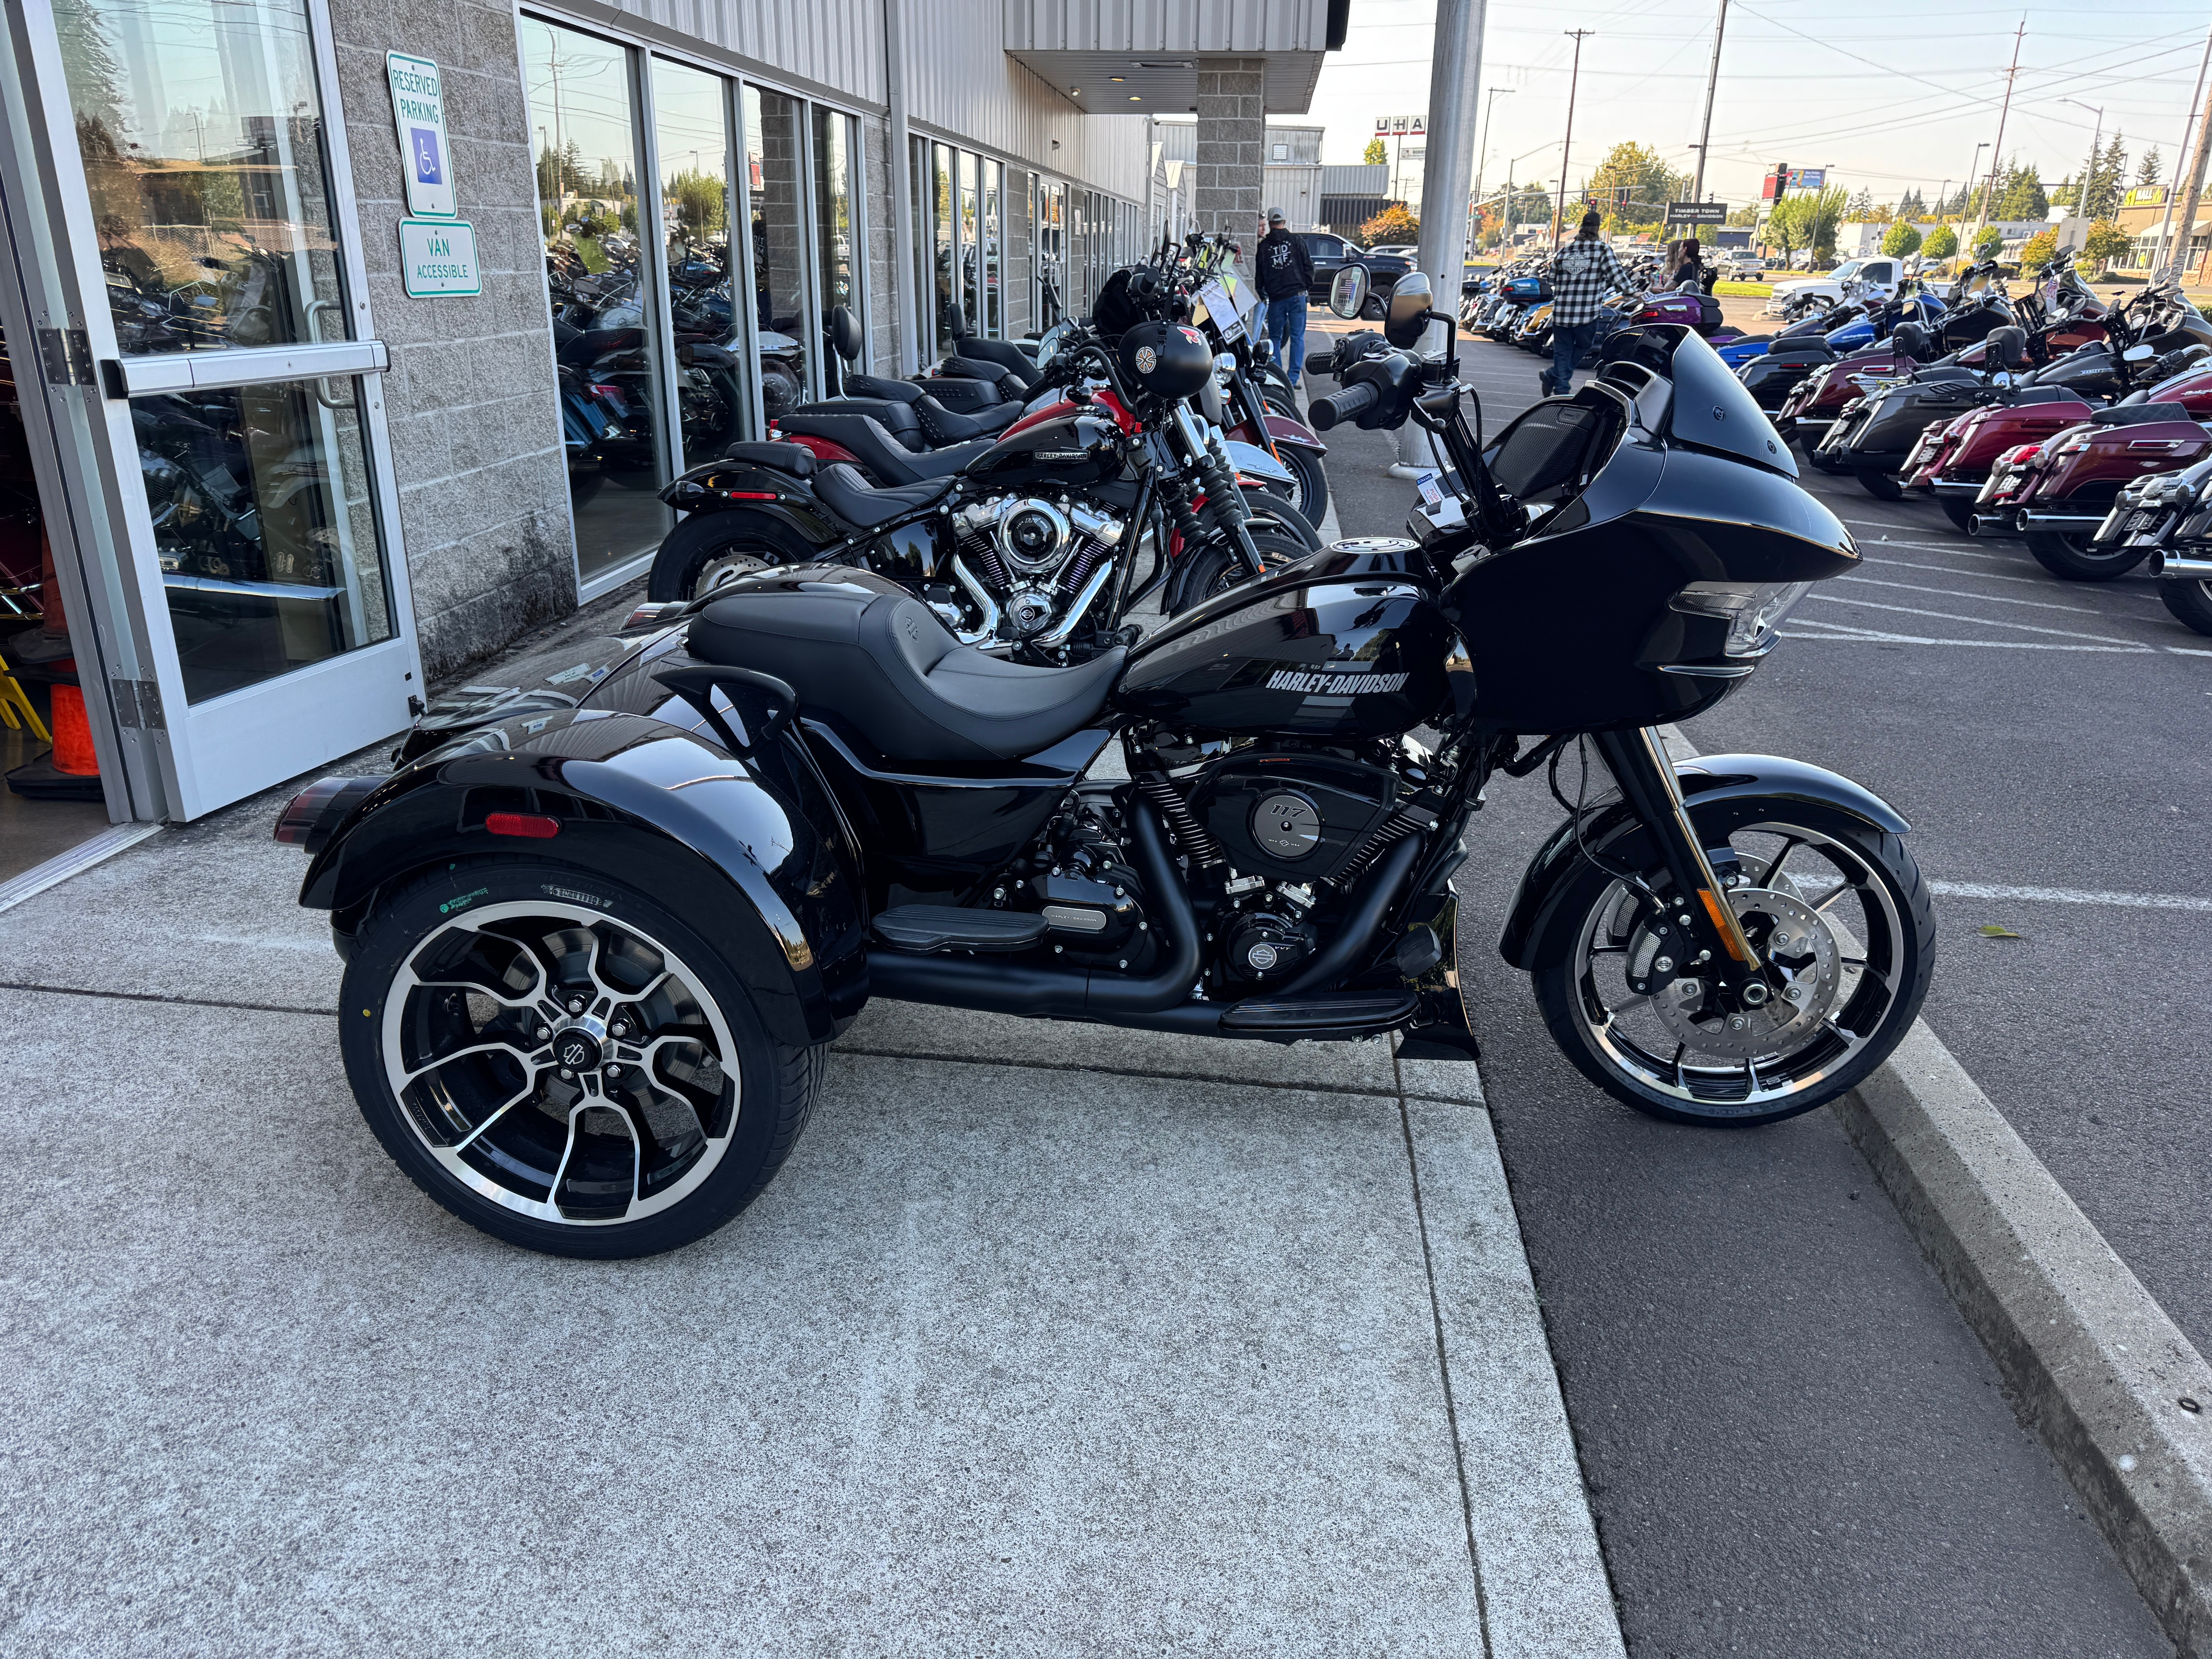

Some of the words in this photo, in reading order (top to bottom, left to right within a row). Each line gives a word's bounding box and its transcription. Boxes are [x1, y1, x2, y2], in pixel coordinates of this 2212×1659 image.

[392, 69, 438, 97] RESERVED
[400, 98, 439, 124] PARKING
[427, 238, 450, 257] VAN
[417, 264, 469, 279] ACCESSIBLE
[1266, 670, 1410, 694] HARLEY-DAVIDSON
[1271, 804, 1308, 818] 117
